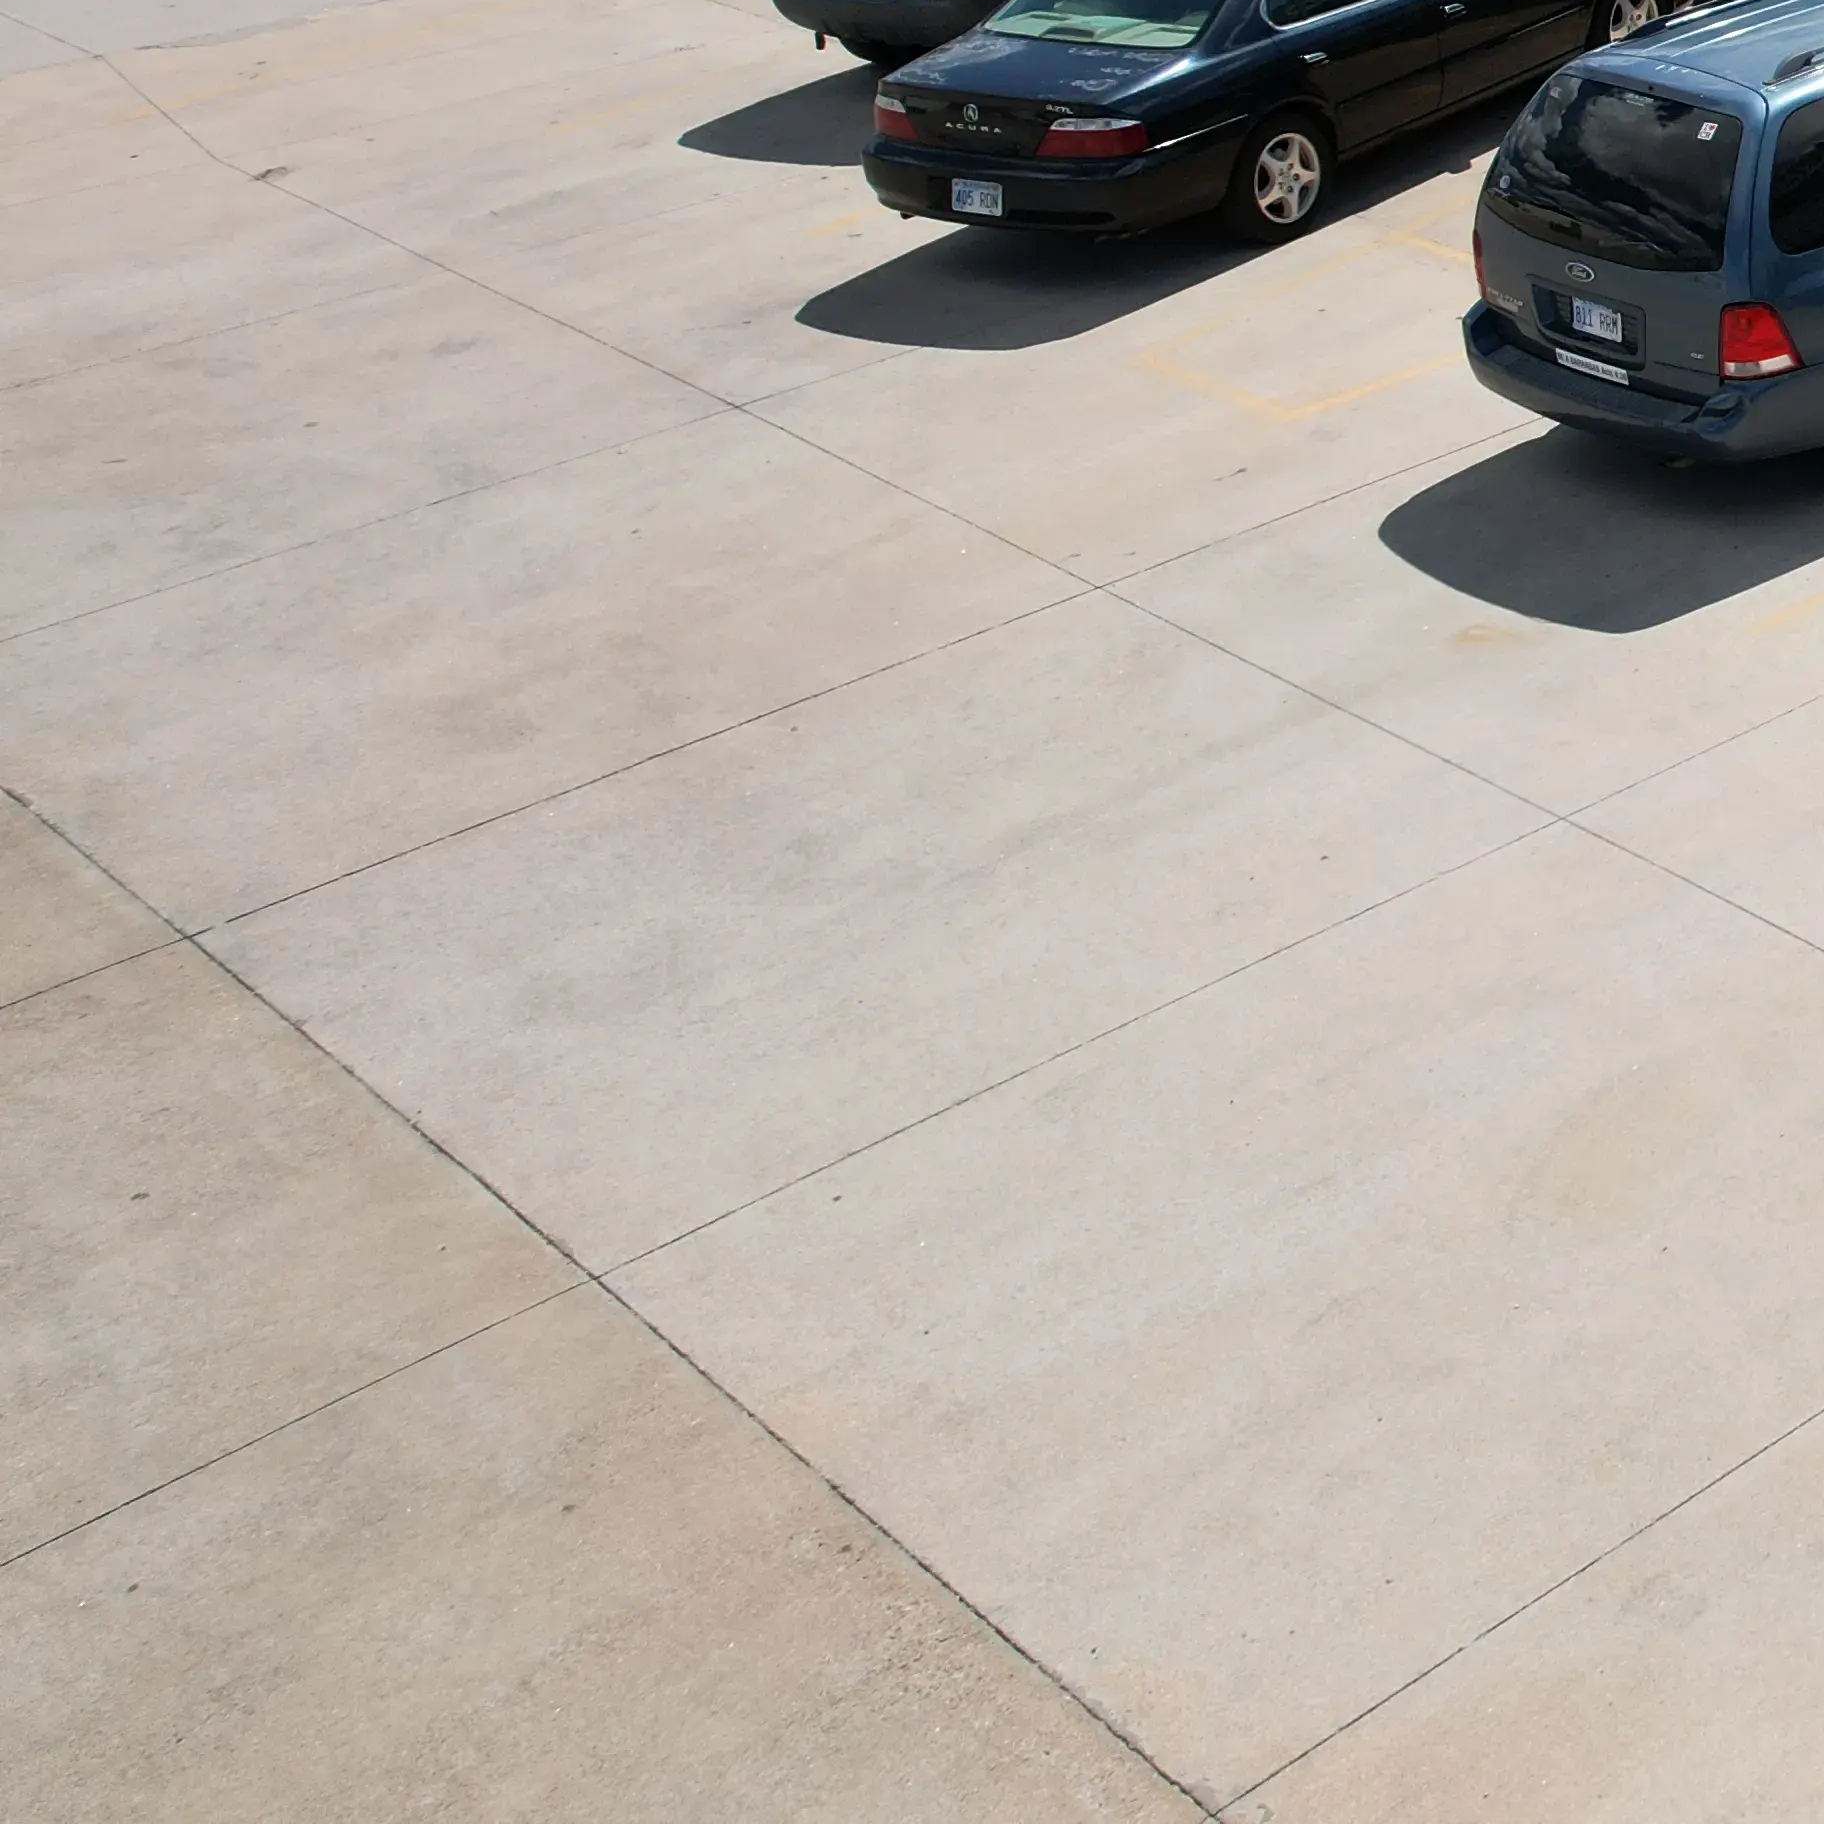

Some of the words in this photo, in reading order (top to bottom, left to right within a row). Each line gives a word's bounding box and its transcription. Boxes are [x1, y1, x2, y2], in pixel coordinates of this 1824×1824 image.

[945, 121, 1003, 135] ACURA
[955, 190, 974, 207] 405
[1575, 306, 1594, 327] 811
